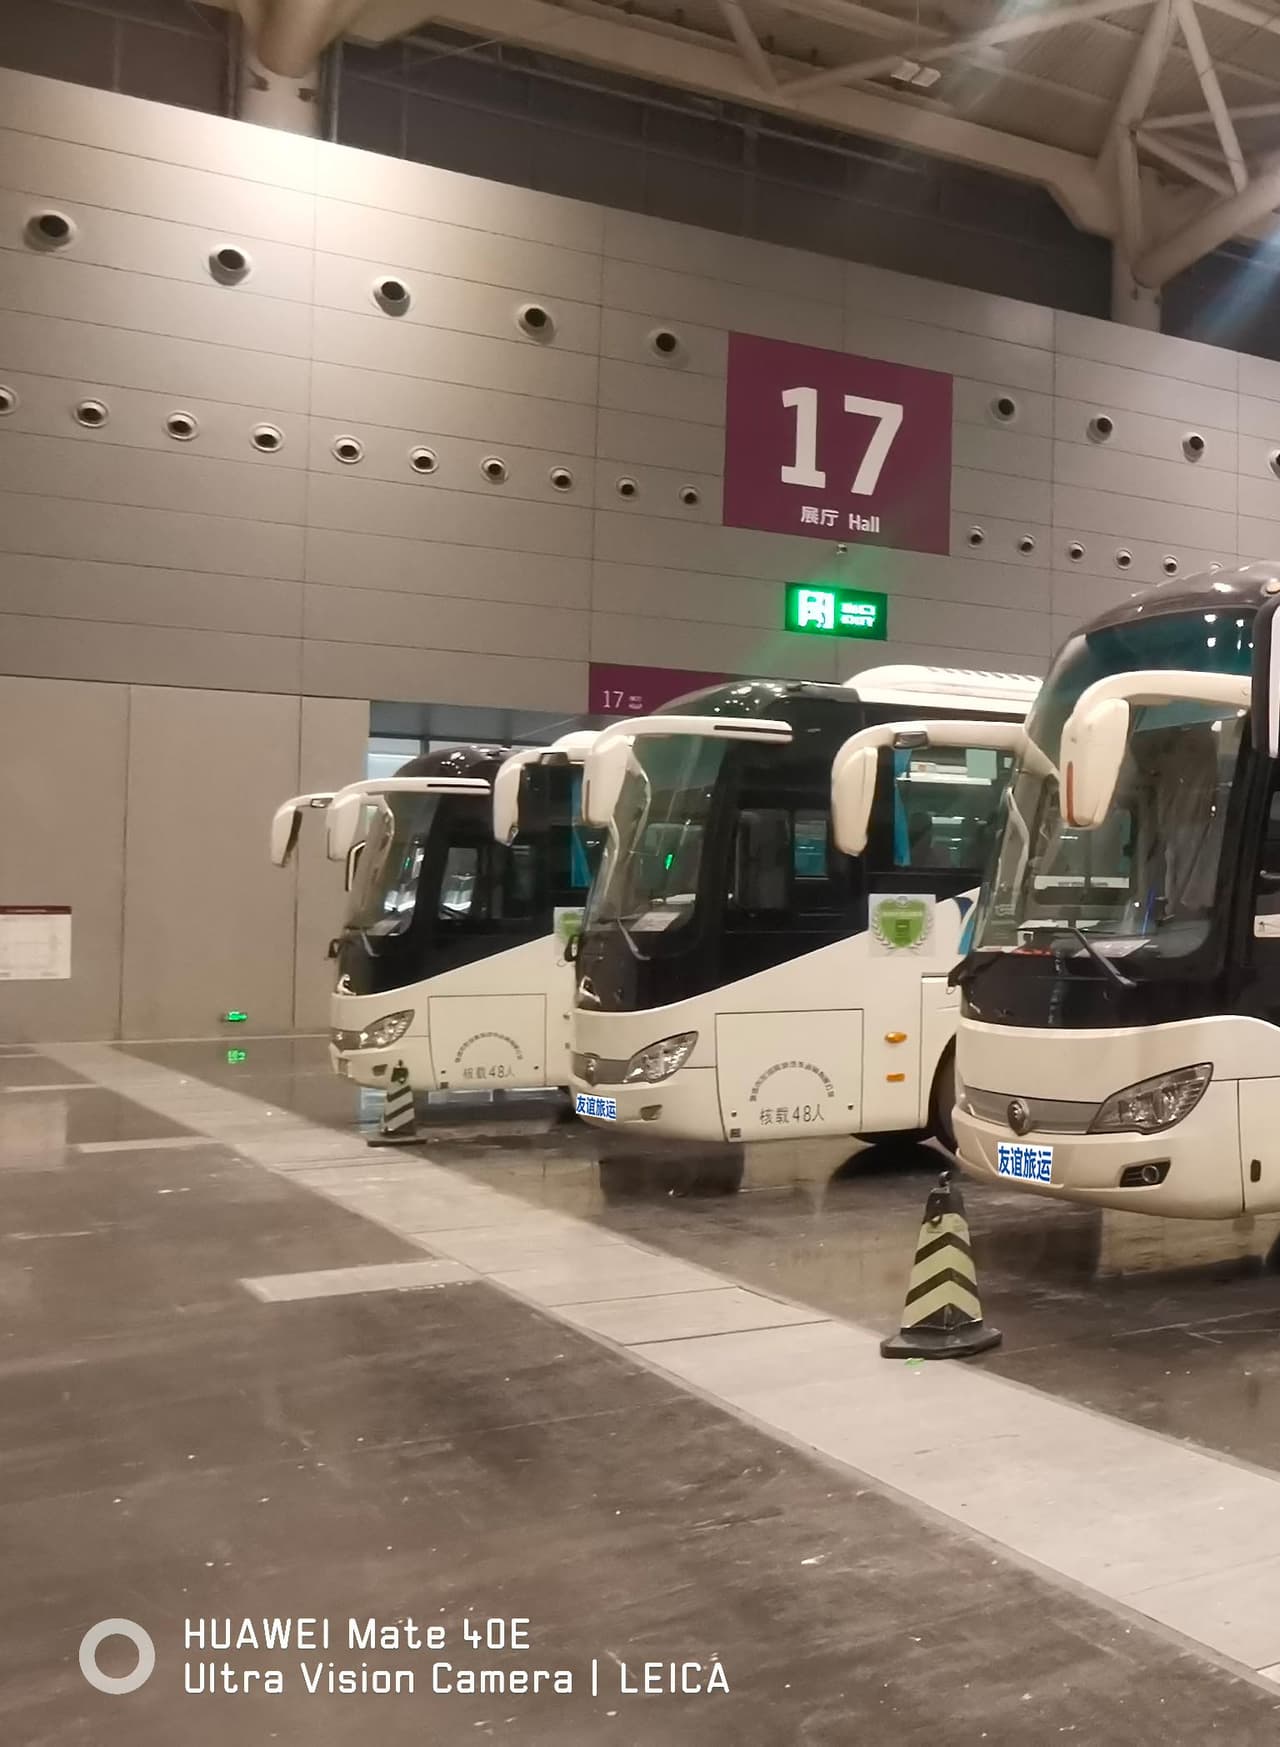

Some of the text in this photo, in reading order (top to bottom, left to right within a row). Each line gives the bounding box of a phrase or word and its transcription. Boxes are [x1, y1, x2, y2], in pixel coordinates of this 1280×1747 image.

[781, 387, 904, 496] 17
[800, 505, 880, 533] 展厅 Hall
[603, 690, 624, 708] 17
